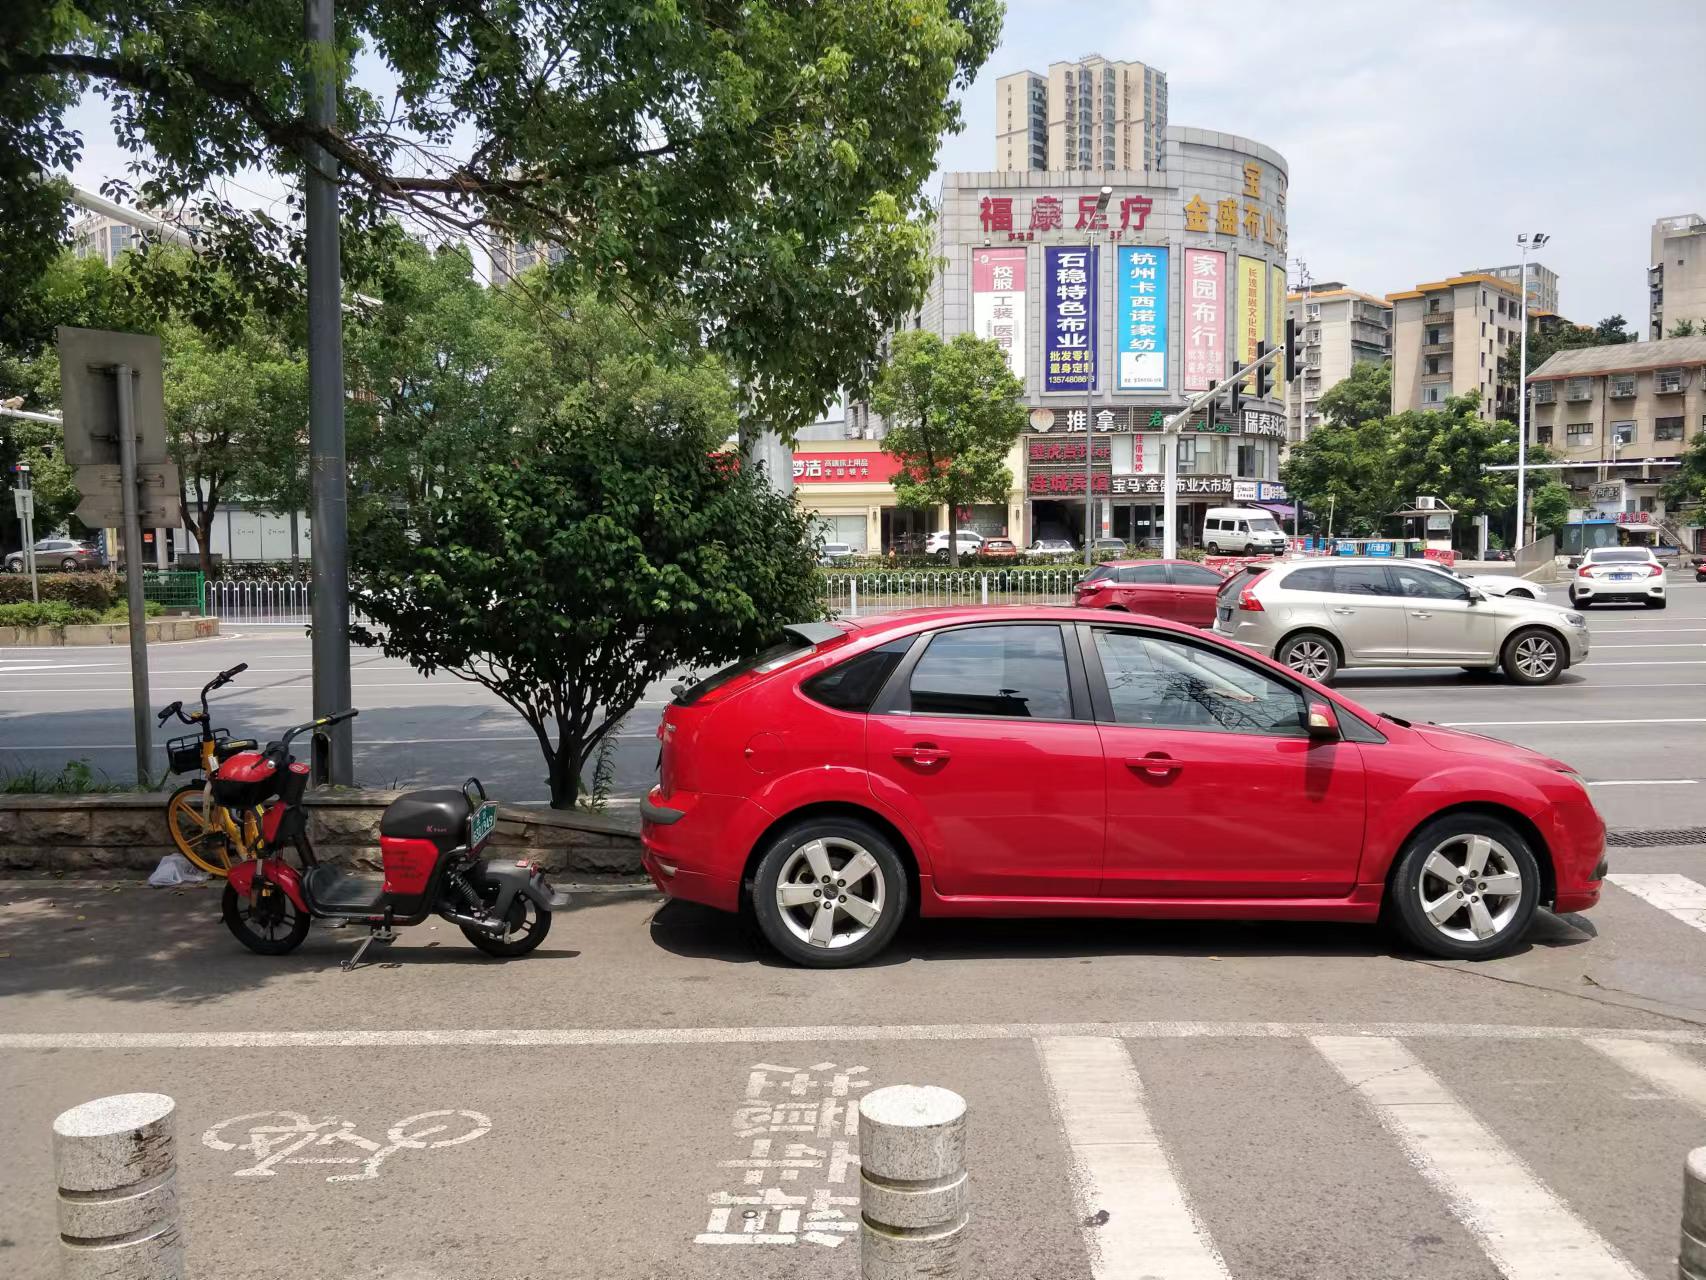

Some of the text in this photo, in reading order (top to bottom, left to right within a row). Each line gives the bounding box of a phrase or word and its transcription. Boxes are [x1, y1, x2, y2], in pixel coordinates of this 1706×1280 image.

[980, 194, 1153, 232] 福康足疗
[1057, 252, 1087, 348] 石稳特色布业
[1130, 253, 1157, 351] 杭州卡西诺家纺
[1192, 255, 1217, 346] 家园布行
[1066, 409, 1116, 432] 推拿
[793, 460, 822, 477] 梦洁
